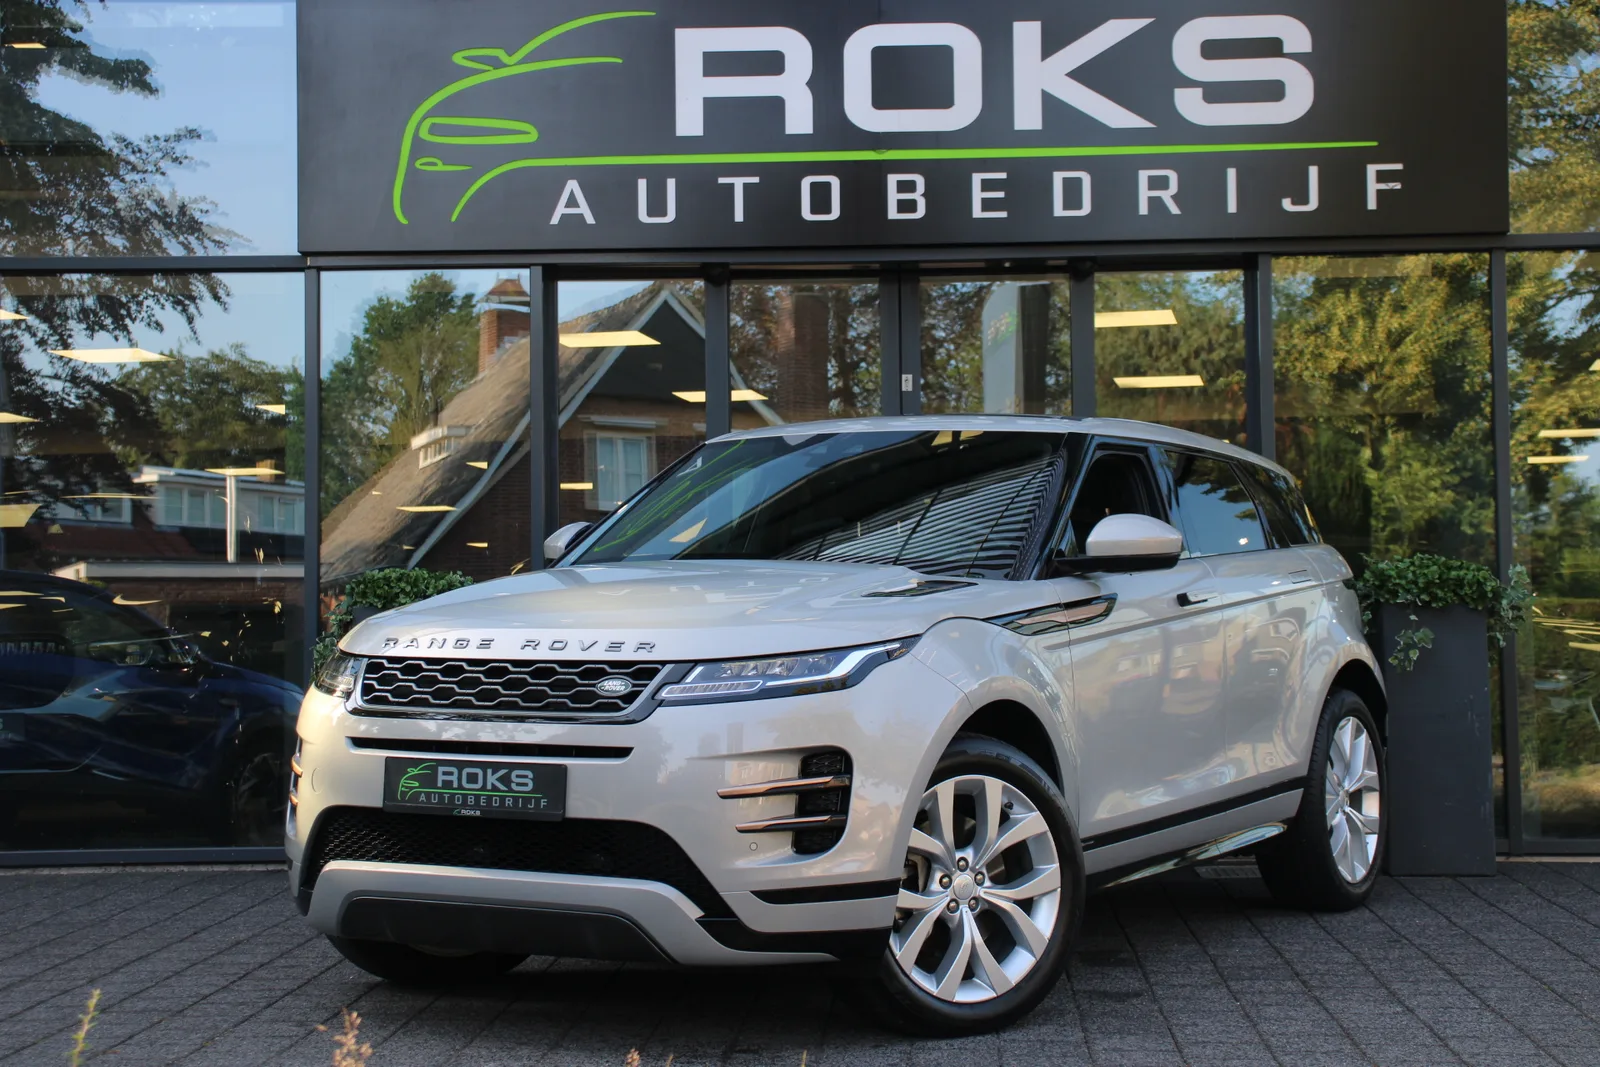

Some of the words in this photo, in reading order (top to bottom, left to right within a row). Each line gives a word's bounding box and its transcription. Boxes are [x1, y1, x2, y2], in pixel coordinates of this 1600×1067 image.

[674, 14, 1314, 137] ROKS
[549, 163, 1404, 226] AUTOBEDRIJF
[381, 637, 495, 650] RANGE
[520, 638, 656, 653] ROVER
[436, 766, 534, 792] ROKS
[419, 793, 548, 809] AUTOBEDRIJF
